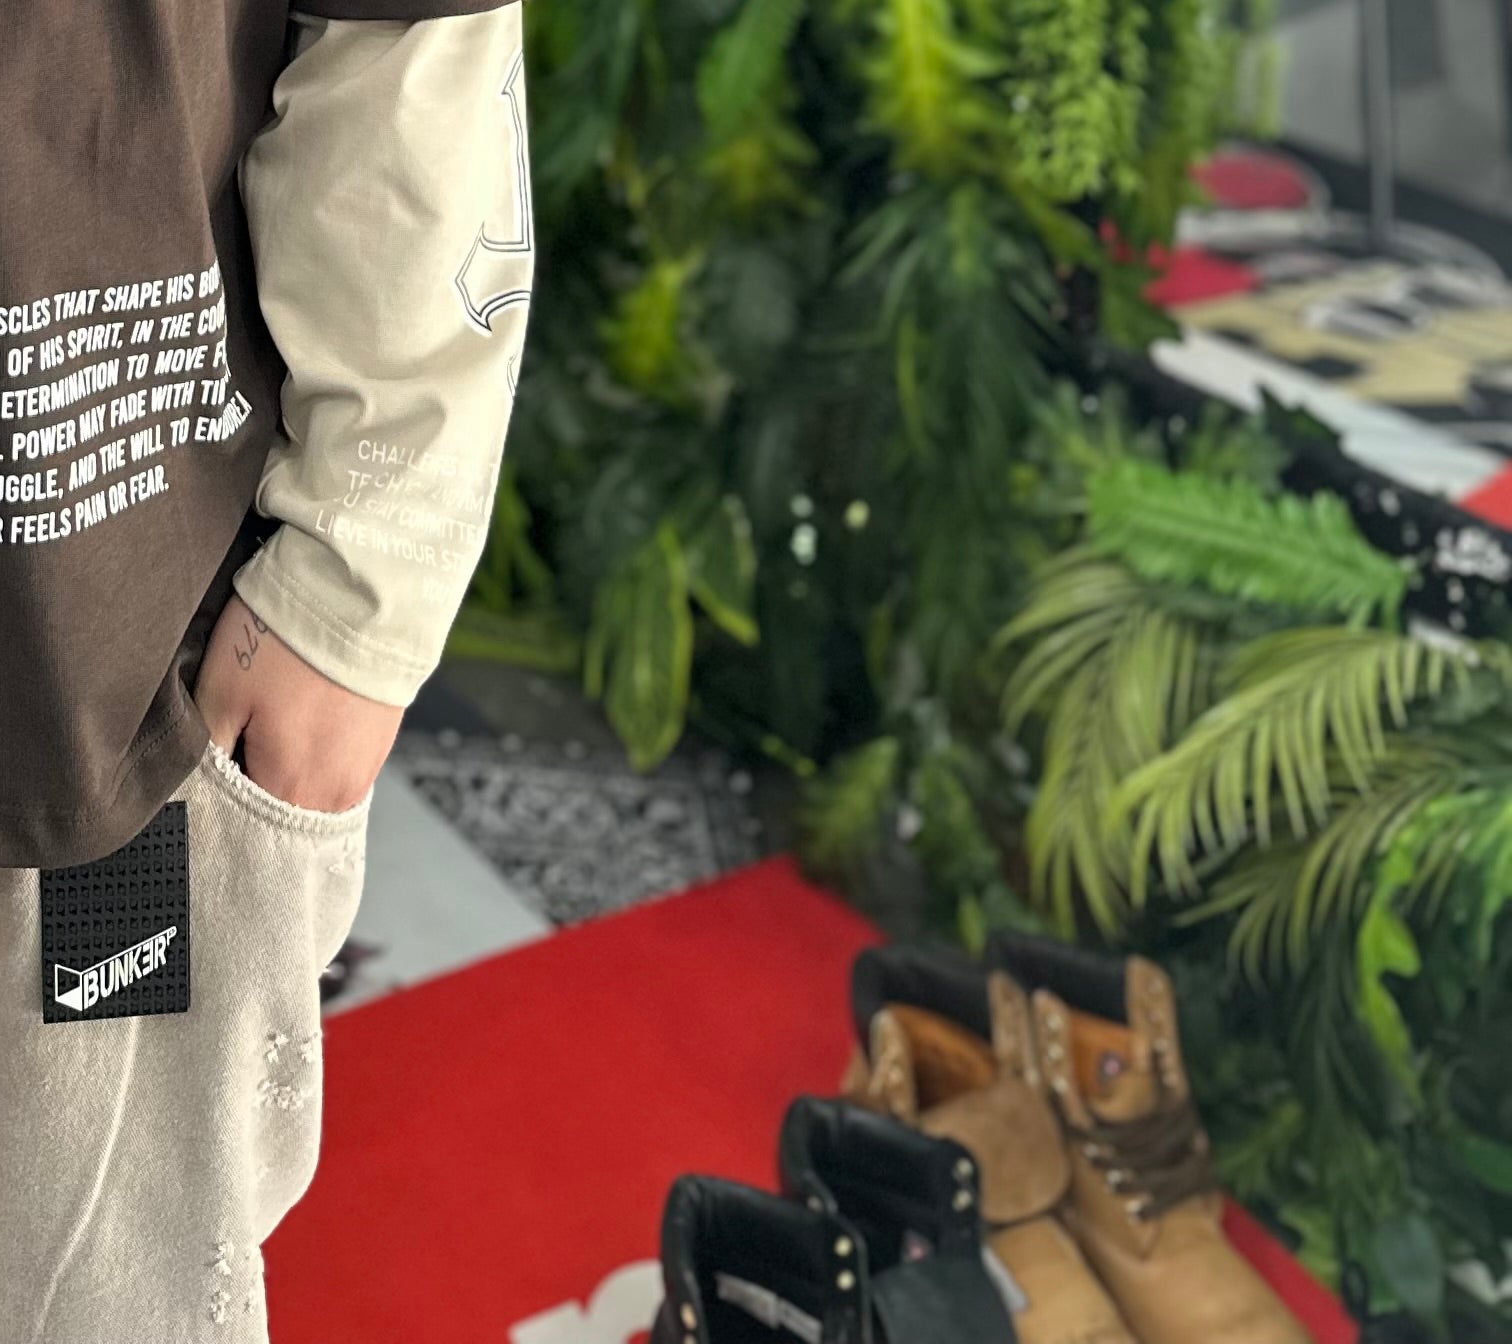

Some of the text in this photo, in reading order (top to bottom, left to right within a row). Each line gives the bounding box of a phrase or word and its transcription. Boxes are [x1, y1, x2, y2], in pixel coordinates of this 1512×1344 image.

[53, 288, 101, 322] THAT
[101, 279, 164, 313] SHAPE
[165, 273, 195, 306] HIS
[7, 345, 35, 378] OF
[39, 334, 65, 372] HIS
[66, 322, 125, 360] SPIRIT,
[130, 318, 155, 345] IN
[159, 312, 195, 342] THE
[126, 352, 150, 382] TO
[153, 344, 209, 376] MOVE
[11, 419, 77, 462] POWER
[78, 403, 107, 444] MAY
[110, 389, 148, 430] FADE
[150, 379, 196, 413] WITH
[68, 452, 97, 492] AND
[98, 438, 127, 476] THE
[129, 423, 165, 463] WILL
[169, 416, 190, 448] TO
[10, 507, 72, 544] FEELS
[74, 490, 108, 533] PAIN
[108, 480, 129, 516] OR
[129, 464, 170, 505] FEAR.
[389, 534, 438, 564] YOUR
